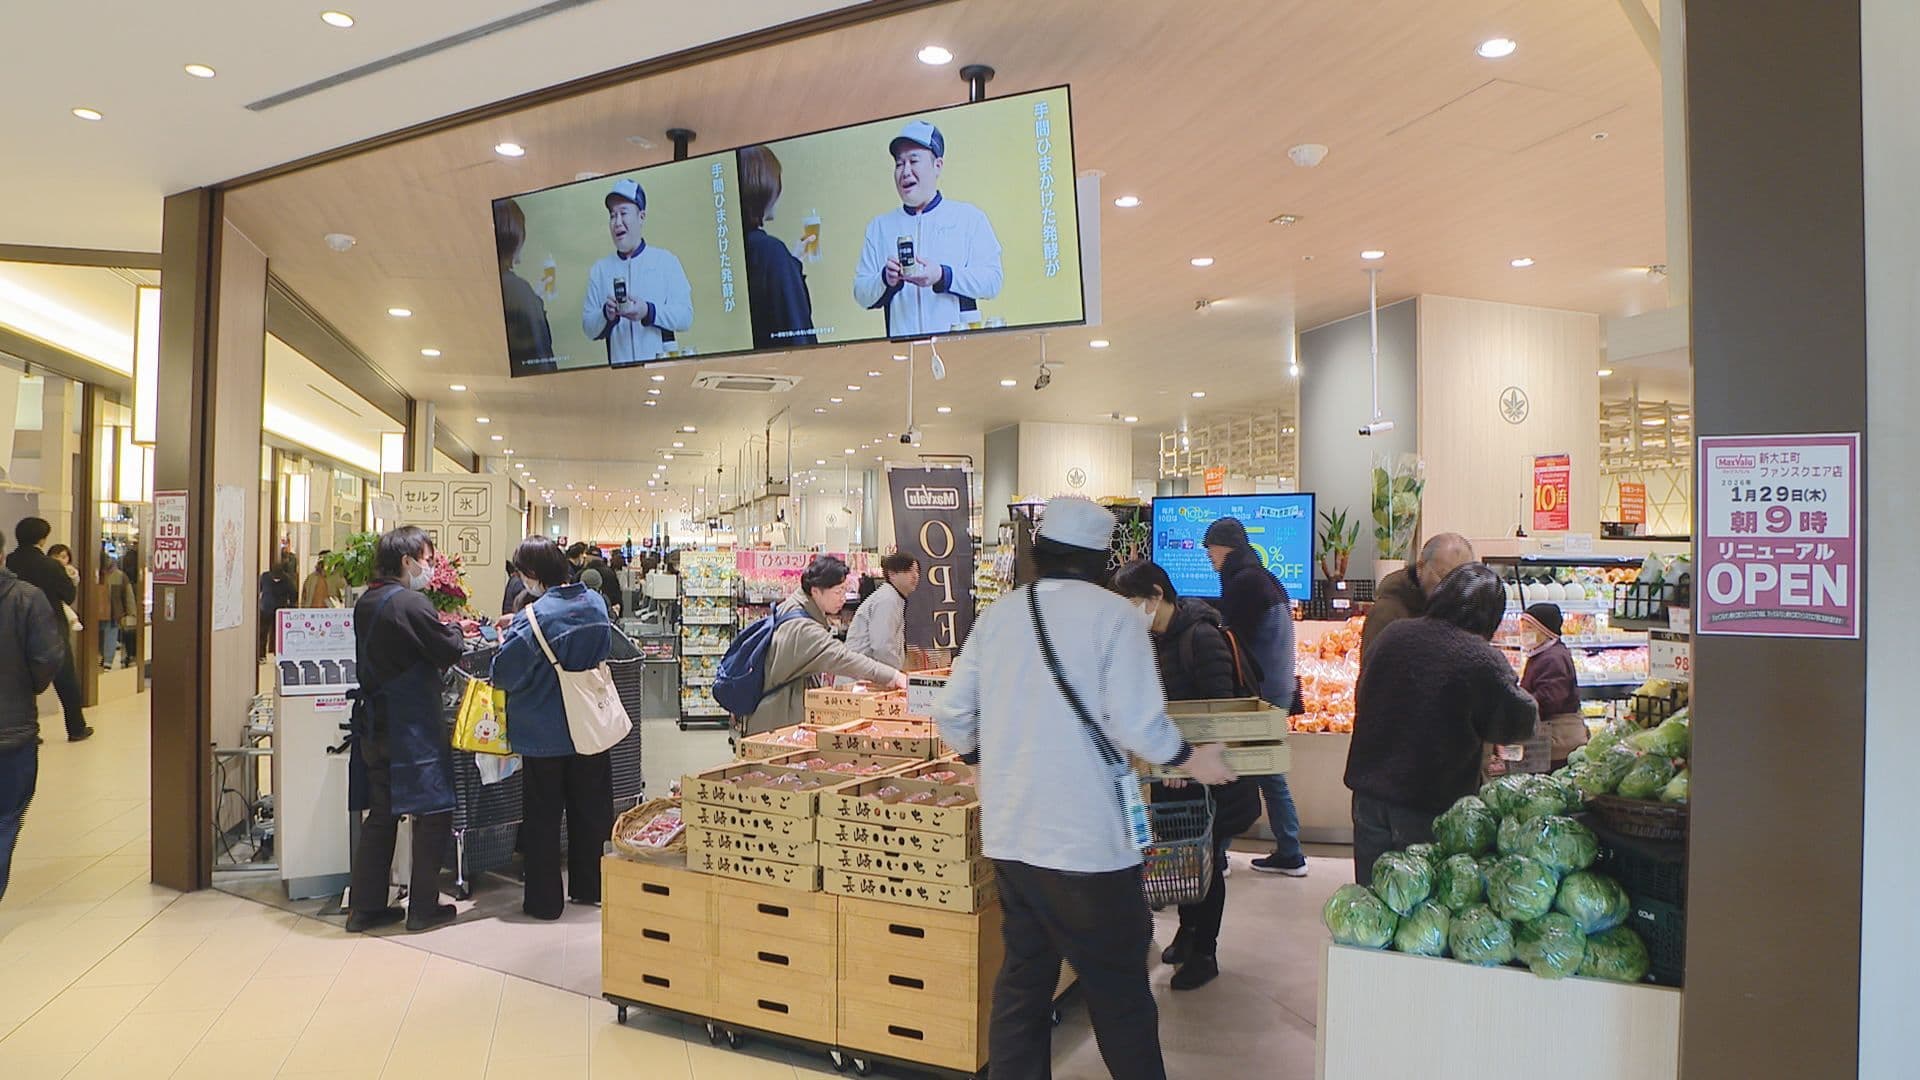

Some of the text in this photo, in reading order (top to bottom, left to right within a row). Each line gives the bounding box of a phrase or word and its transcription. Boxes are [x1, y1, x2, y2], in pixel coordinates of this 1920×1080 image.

[1033, 102, 1060, 278] 手間ひまかけた発酵が
[711, 162, 736, 313] 手間ひまかけた発酵が
[1717, 453, 1754, 466] MaxValu
[1759, 452, 1800, 464] 新大工町
[1759, 466, 1843, 478] ファンスクエア店
[404, 490, 440, 502] セルフ
[459, 497, 473, 510] 氷
[1731, 486, 1828, 502] 1月29日(木)
[405, 505, 440, 513] サービス
[1731, 505, 1828, 534] 朝9時
[154, 549, 185, 570] OPEN
[1719, 542, 1836, 560] リニューアル
[1706, 562, 1848, 607] OPEN
[1675, 656, 1690, 671] 98
[832, 735, 921, 754] 長崎いちご
[697, 783, 791, 810] 長崎いちご
[697, 807, 793, 834] 長崎いちご
[837, 799, 945, 828] 長崎いちご
[702, 831, 799, 858] 長崎いちご
[835, 824, 944, 853] 長崎いちご
[702, 853, 794, 883] 長崎いちご
[838, 849, 948, 878] 長崎いちご
[842, 875, 951, 904] 長崎いちご
